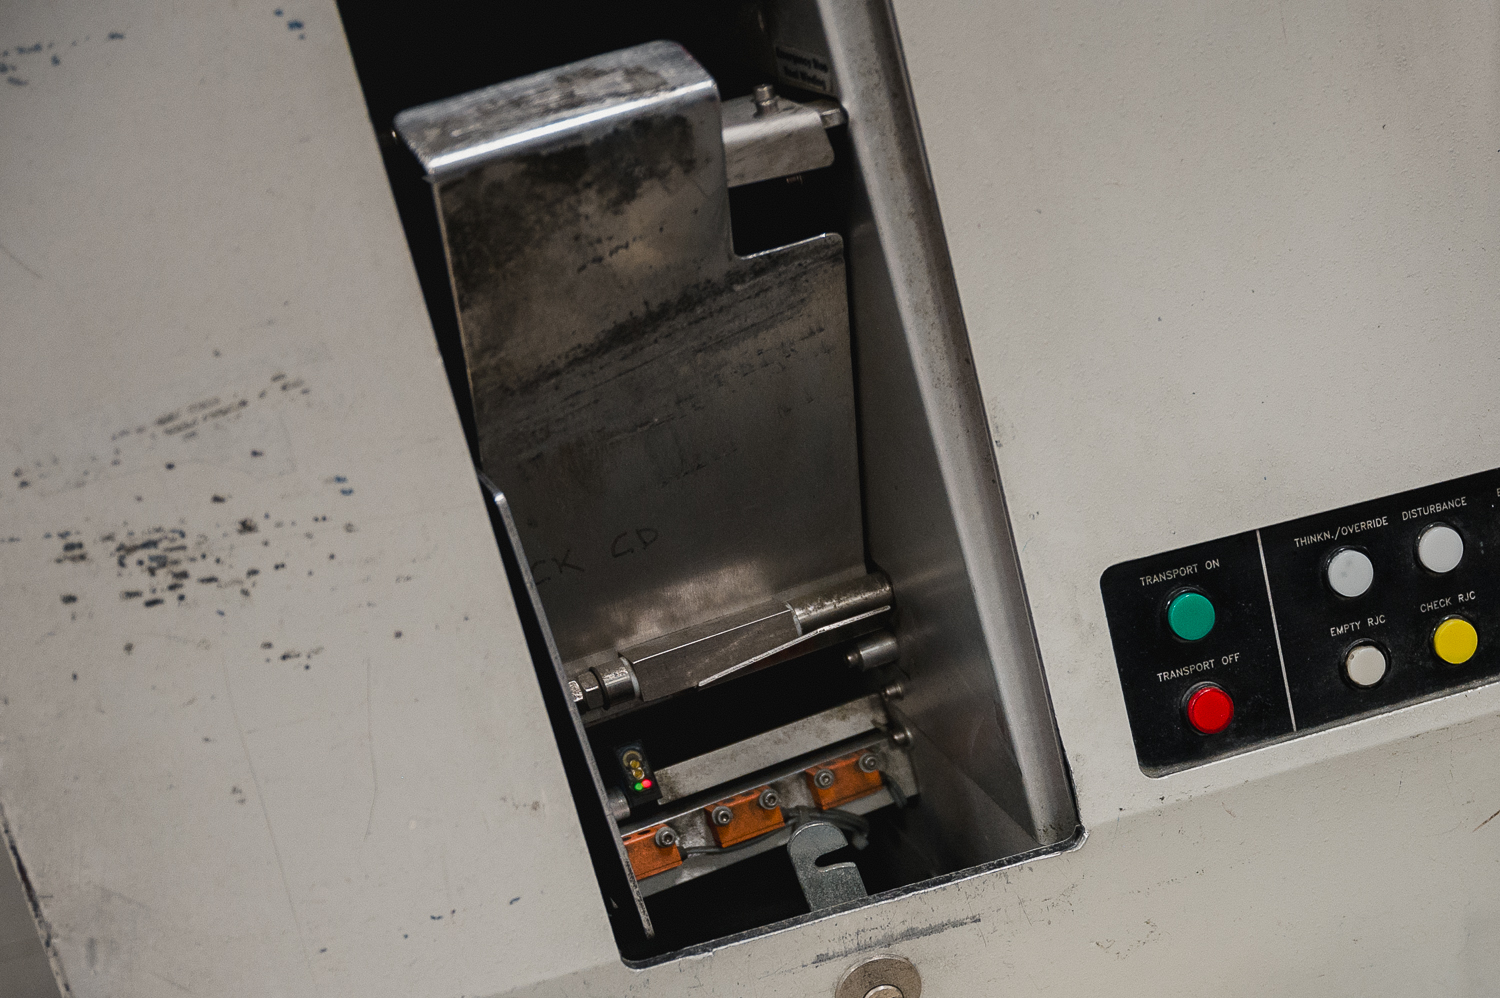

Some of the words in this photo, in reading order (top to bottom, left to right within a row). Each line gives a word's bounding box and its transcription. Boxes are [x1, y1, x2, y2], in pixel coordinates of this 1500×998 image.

[1401, 496, 1467, 521] DISTURBANCE
[1294, 516, 1389, 548] THINKN./OVERRIDE
[1139, 563, 1199, 587] TRANSPORT
[1205, 558, 1221, 570] ON
[1420, 596, 1452, 613] CHECK
[1458, 590, 1476, 604] RJC
[1330, 620, 1361, 637] EMPTY
[1367, 614, 1386, 628] RJC
[1157, 659, 1216, 682] TRANSPORT
[1221, 652, 1240, 666] OFF
